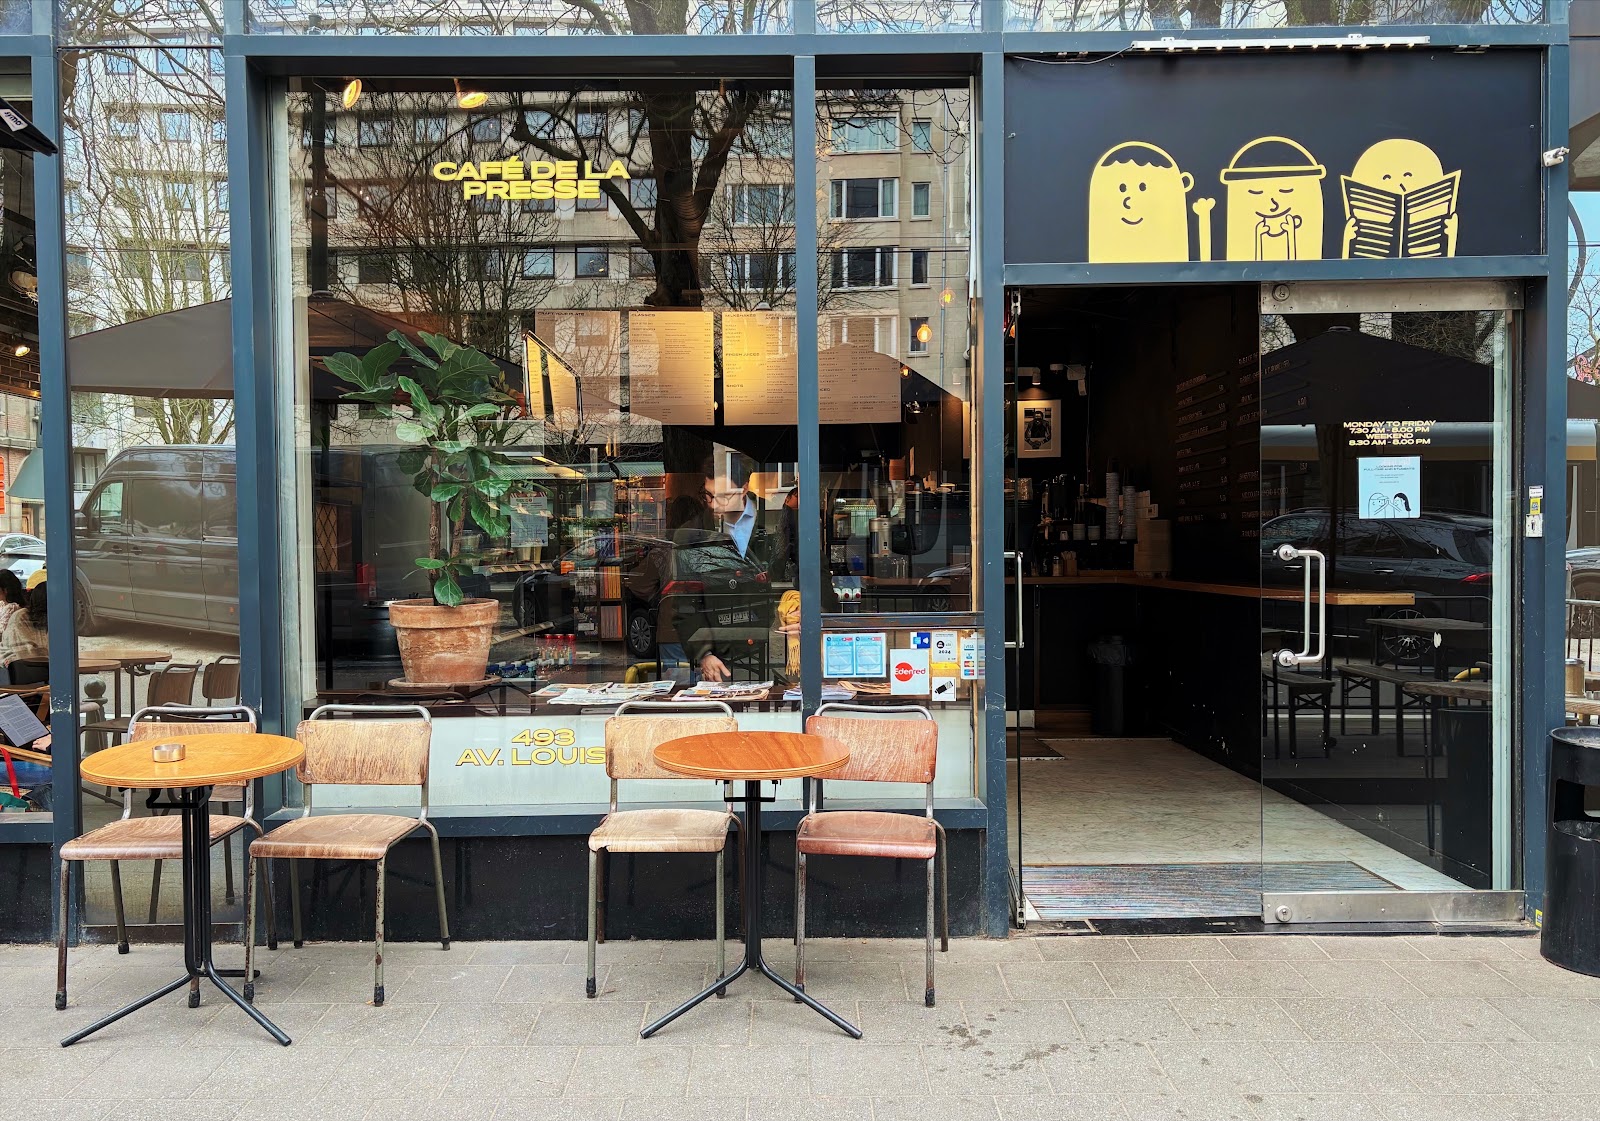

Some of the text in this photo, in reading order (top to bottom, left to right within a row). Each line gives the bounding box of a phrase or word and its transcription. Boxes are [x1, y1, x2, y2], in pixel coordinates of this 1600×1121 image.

[433, 155, 631, 181] CAFÉ DE LA
[463, 180, 600, 200] PRESSE
[511, 728, 576, 747] 493
[455, 748, 505, 767] AV.
